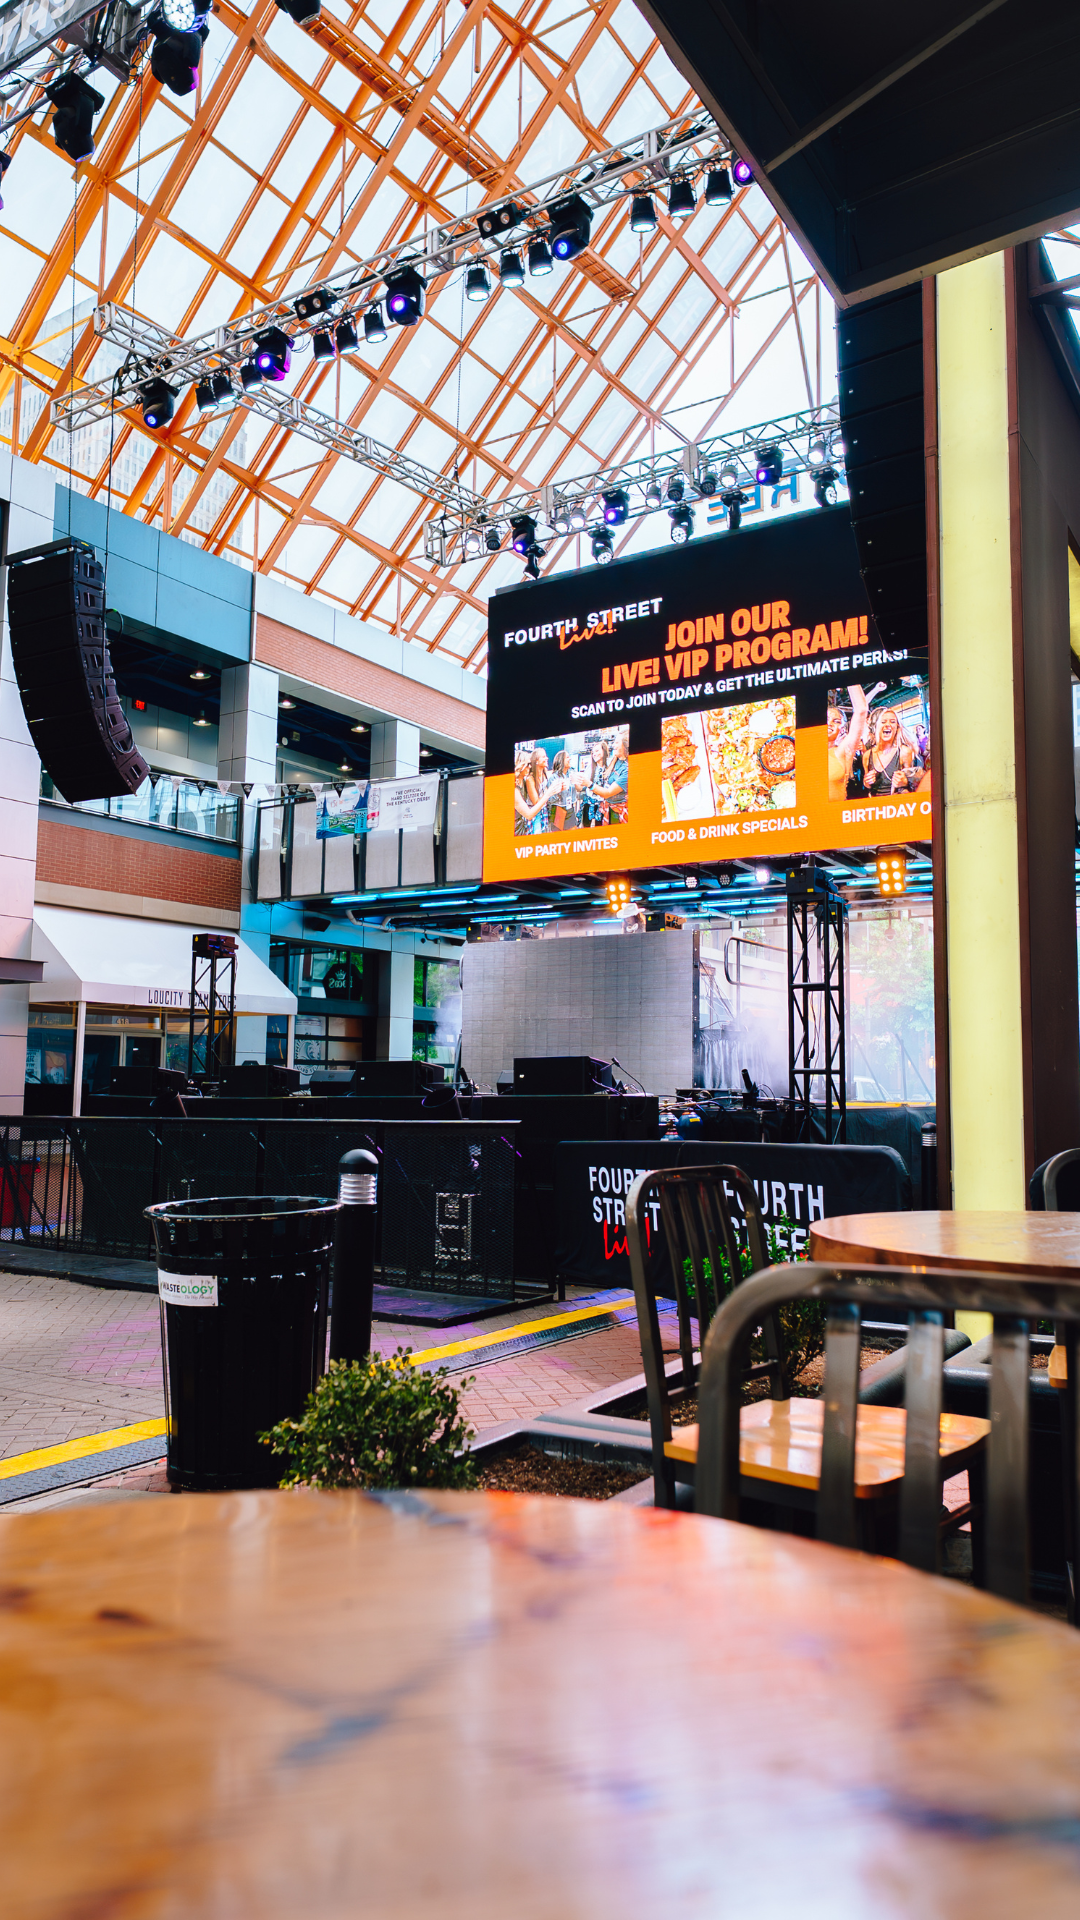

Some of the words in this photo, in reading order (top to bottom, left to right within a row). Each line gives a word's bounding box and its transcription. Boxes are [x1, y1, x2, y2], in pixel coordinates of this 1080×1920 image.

[504, 617, 577, 647] FOURTH
[587, 597, 663, 629] STREET
[664, 615, 725, 652] JOIN
[730, 600, 791, 633] OUR
[601, 659, 661, 694] LIVE!
[664, 651, 709, 682] VIP
[715, 615, 869, 673] PROGRAM!
[571, 702, 603, 719] SCAN
[605, 698, 624, 712] TO
[626, 692, 657, 709] JOIN
[659, 685, 703, 704] TODAY
[704, 682, 714, 695] &
[716, 677, 744, 693] GET
[745, 672, 774, 688] THE
[776, 657, 850, 682] ULTIMATE
[651, 828, 685, 845] FOOD
[688, 827, 697, 840] &
[699, 822, 740, 837] DRINK
[742, 815, 808, 834] SPECIALS
[842, 803, 917, 824] BIRTHDAY
[515, 845, 533, 859] VIP
[535, 840, 571, 857] PARTY
[572, 835, 618, 853] INVITES
[148, 990, 183, 1006] LOUCITY
